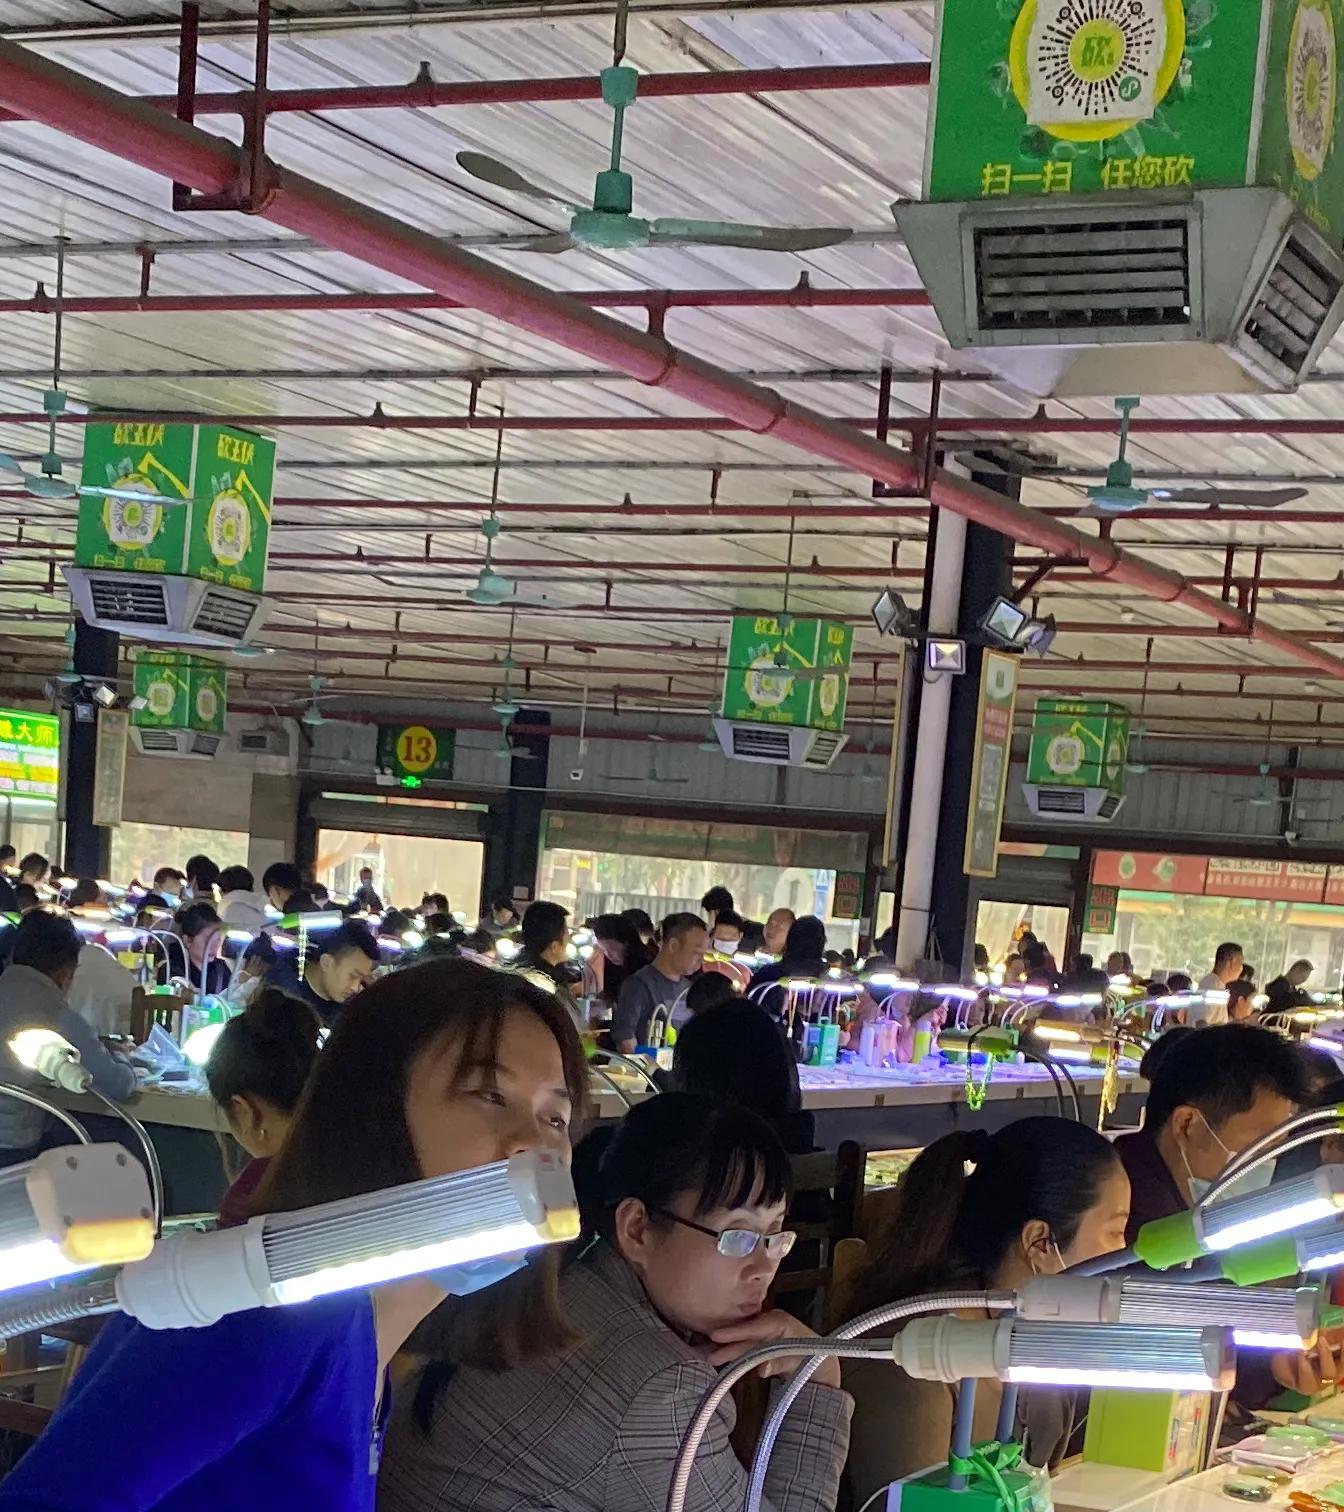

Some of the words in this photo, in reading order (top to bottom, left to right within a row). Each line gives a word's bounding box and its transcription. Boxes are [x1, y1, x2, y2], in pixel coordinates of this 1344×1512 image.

[982, 162, 1072, 196] 扫一扫
[1101, 154, 1196, 190] 任您砍
[403, 735, 433, 763] 13
